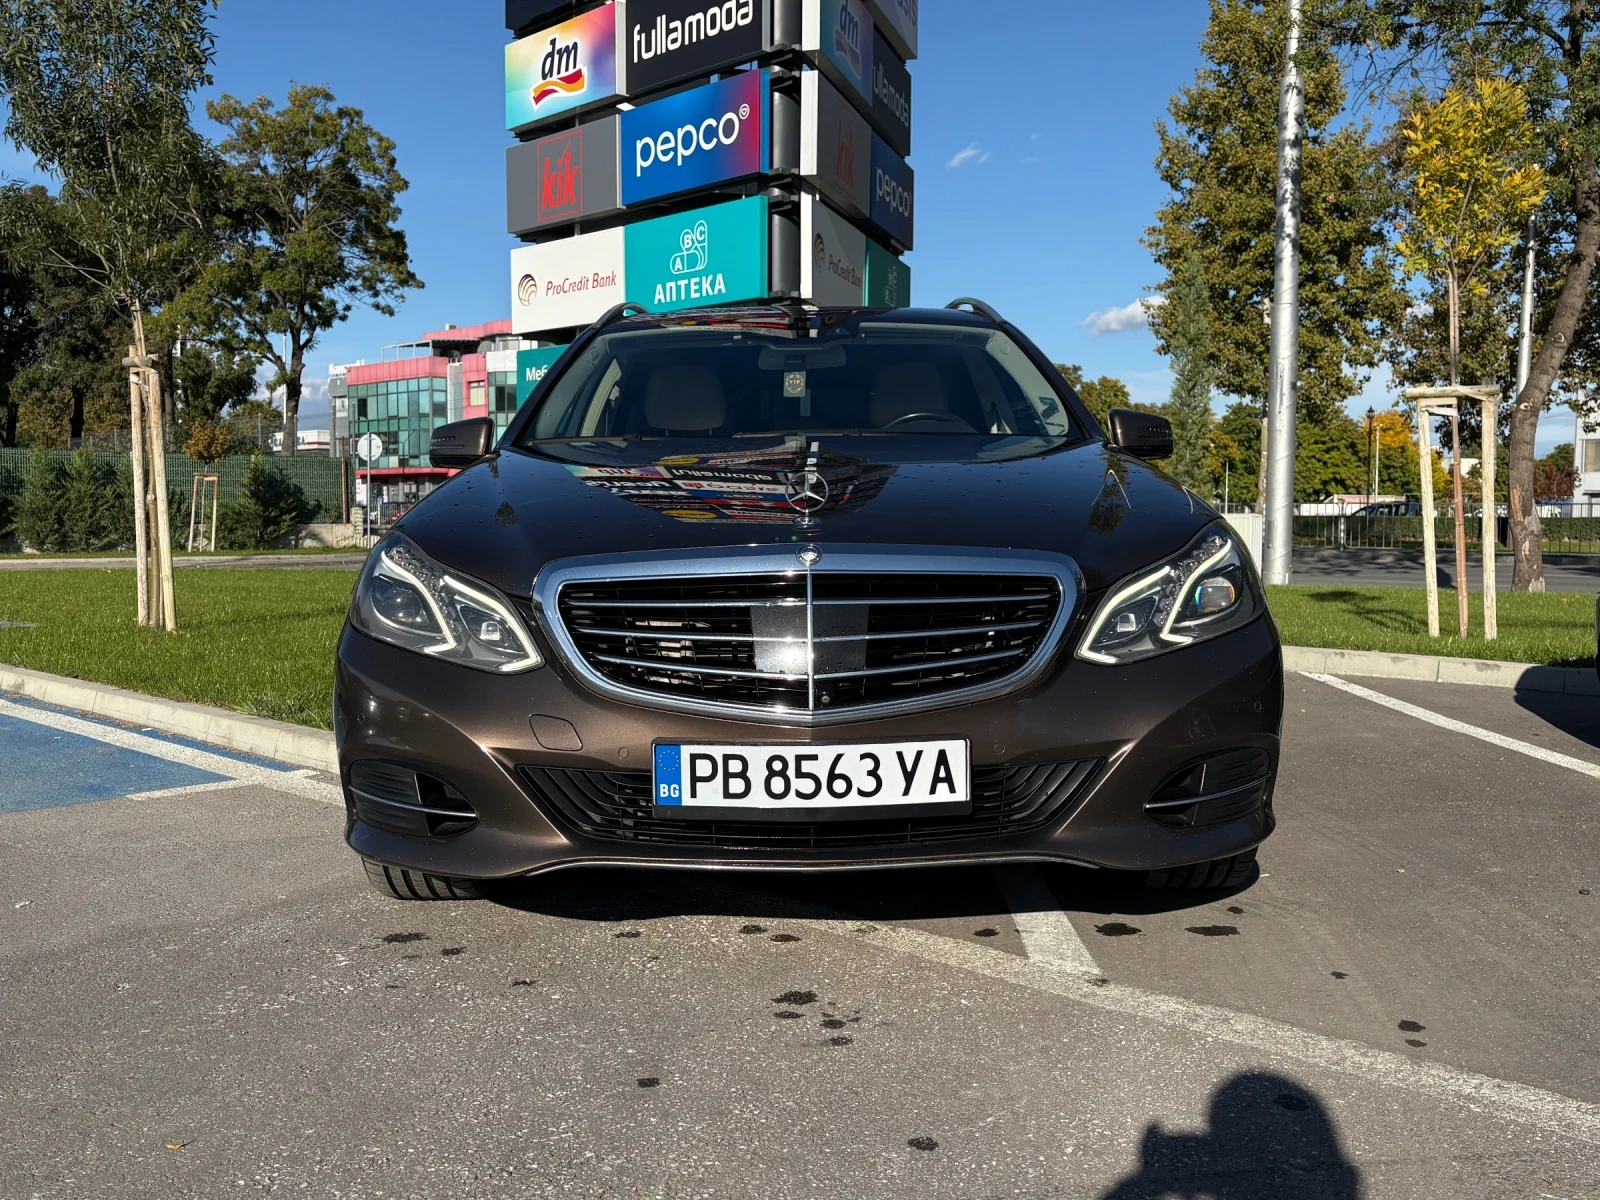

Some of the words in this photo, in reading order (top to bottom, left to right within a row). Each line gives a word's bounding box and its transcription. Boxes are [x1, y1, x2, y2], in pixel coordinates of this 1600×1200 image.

[633, 0, 753, 63] fullamoda
[840, 0, 859, 49] dm
[541, 37, 578, 81] dm
[873, 62, 909, 127] ullamoda
[636, 112, 740, 177] pepco
[542, 141, 578, 211] kik
[876, 167, 909, 217] pepco
[545, 276, 590, 296] ProCredit
[591, 270, 617, 289] Bank
[653, 273, 726, 304] АПТЕКА
[659, 784, 680, 797] BG
[689, 752, 752, 799] PB
[763, 751, 883, 800] 8563
[895, 748, 957, 797] YA
